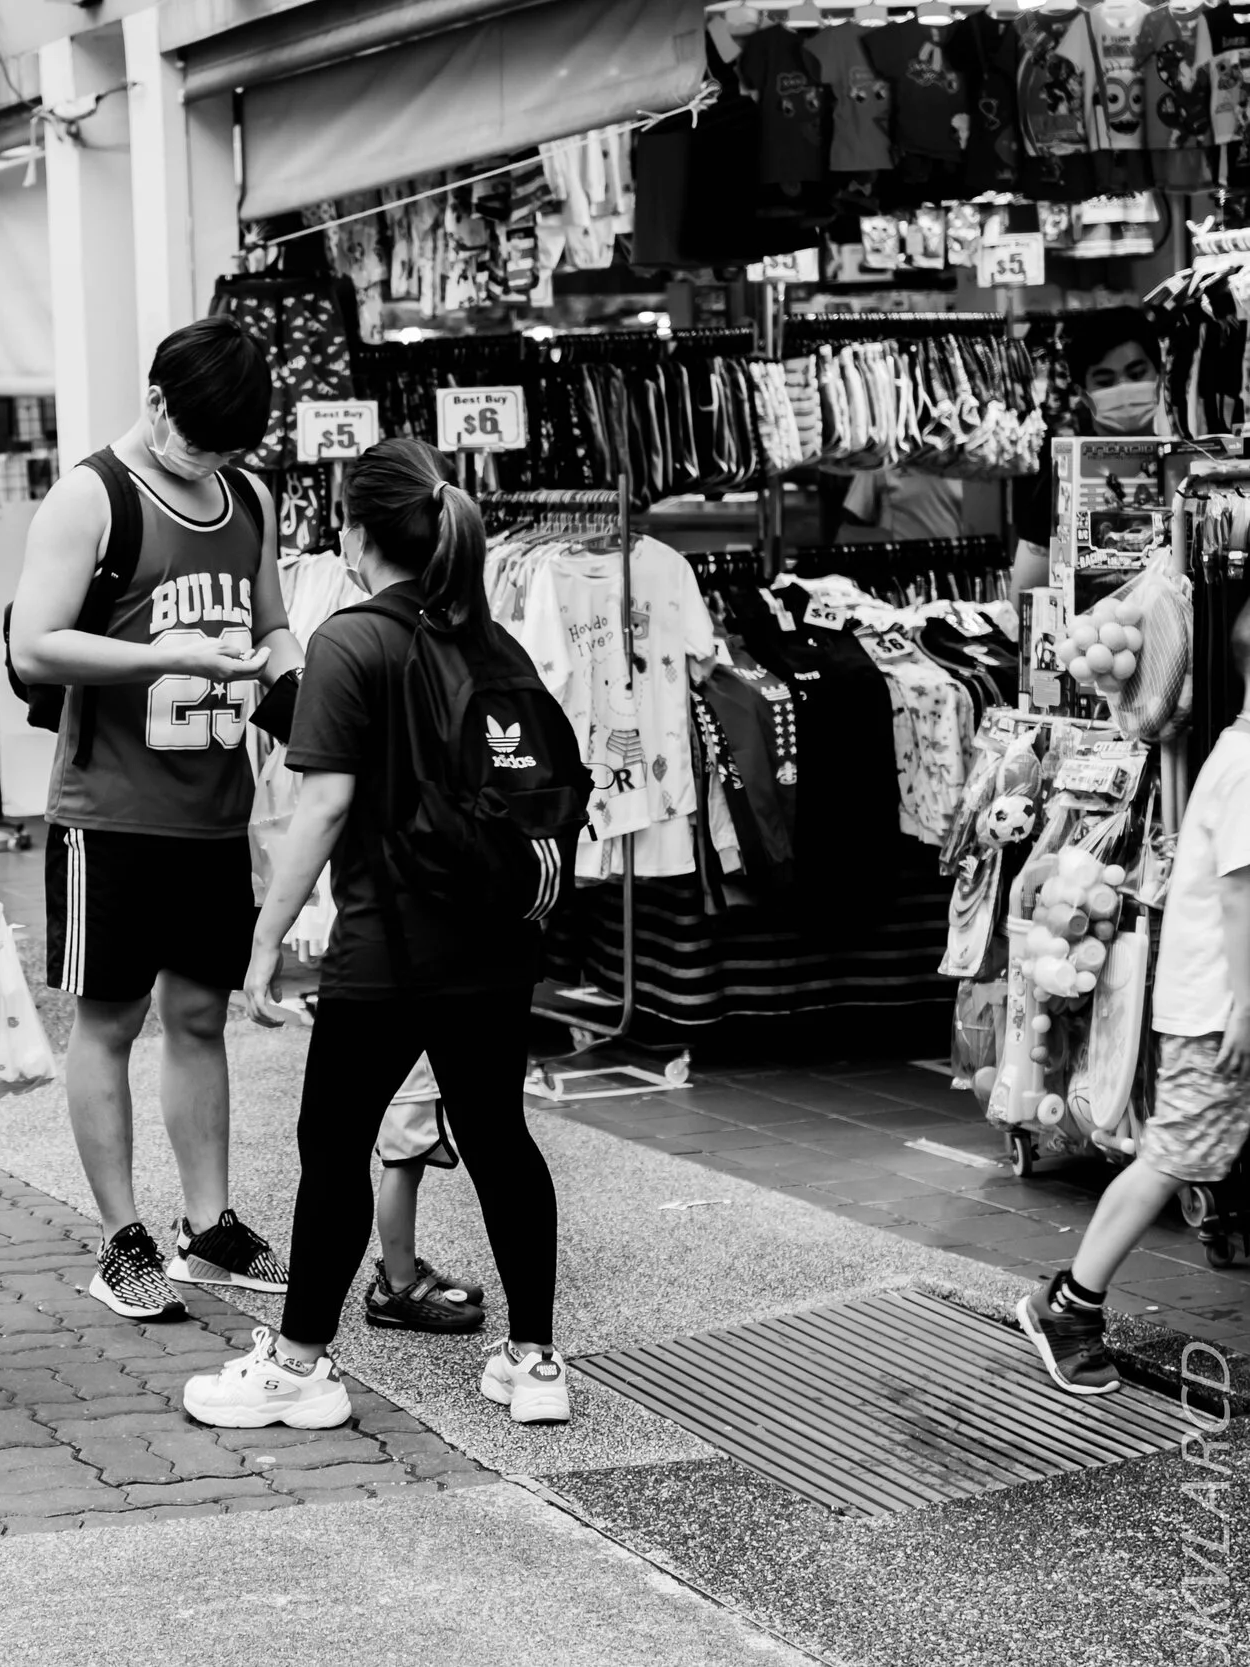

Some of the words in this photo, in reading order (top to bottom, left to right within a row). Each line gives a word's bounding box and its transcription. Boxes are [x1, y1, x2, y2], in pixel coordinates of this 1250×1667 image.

[997, 253, 1024, 275] $5
[454, 396, 481, 405] Best
[485, 395, 508, 405] Buy
[463, 408, 501, 435] $6
[322, 423, 357, 449] $5
[150, 572, 252, 634] BULLS
[810, 607, 837, 621] $6
[593, 615, 608, 630] do
[876, 638, 905, 653] $6
[146, 627, 253, 750] 23
